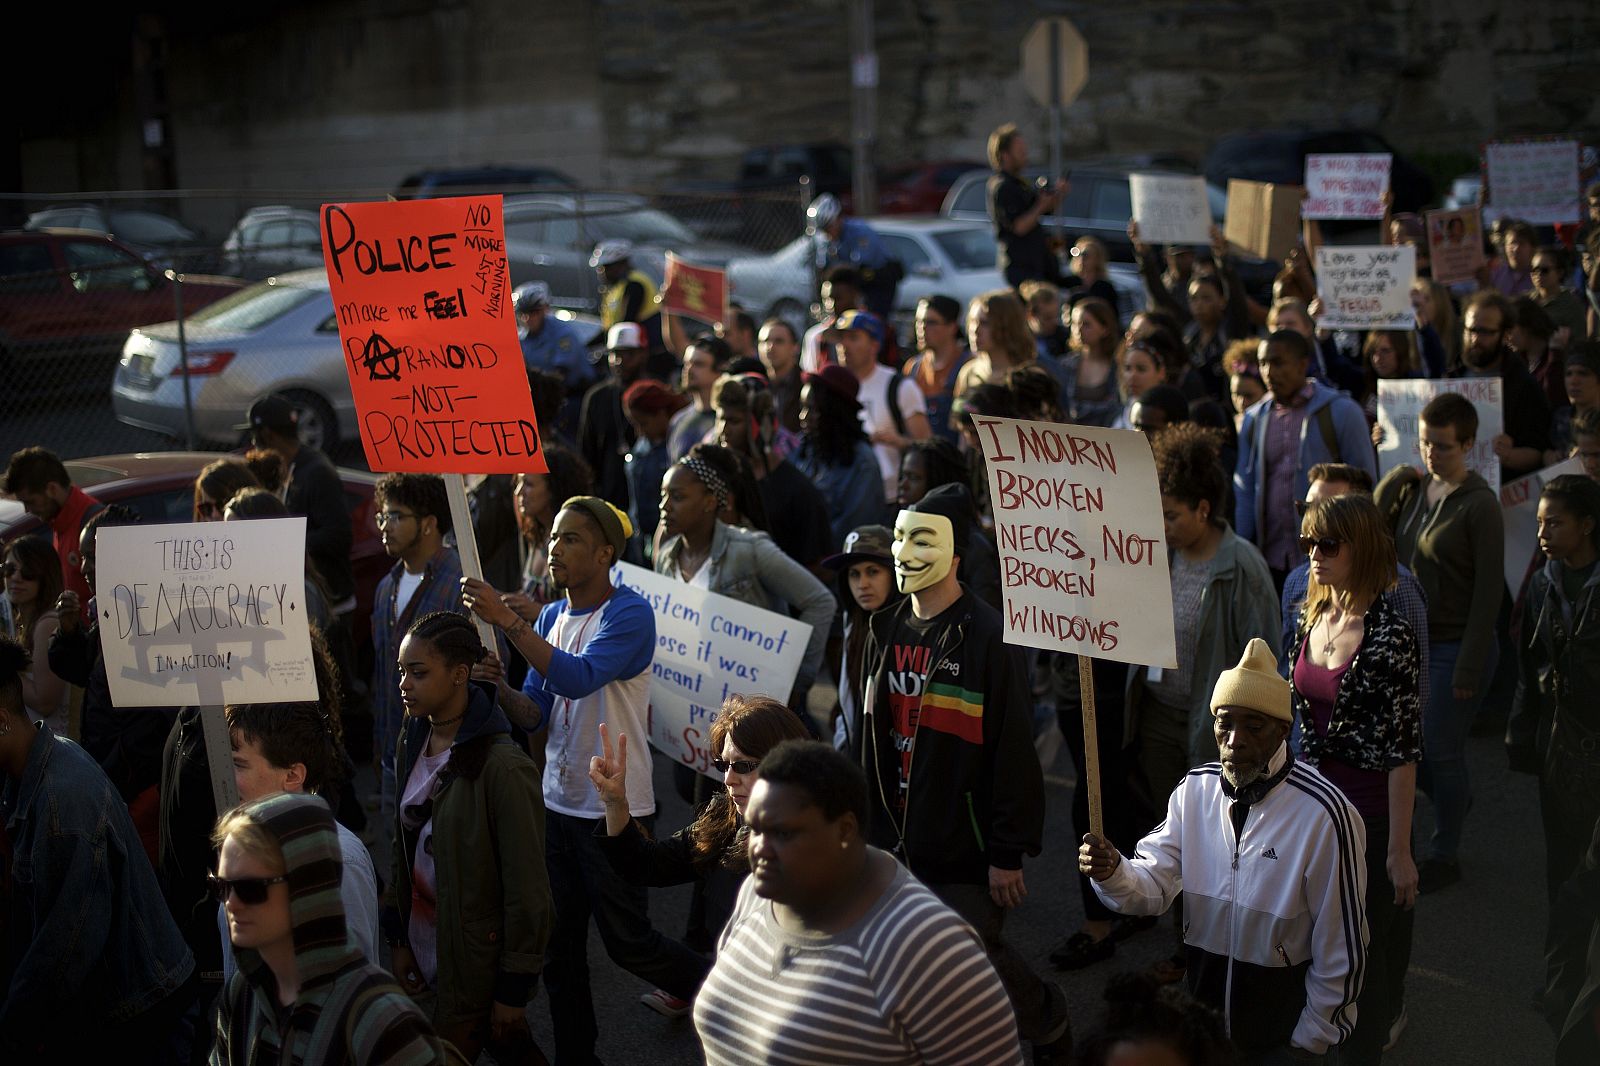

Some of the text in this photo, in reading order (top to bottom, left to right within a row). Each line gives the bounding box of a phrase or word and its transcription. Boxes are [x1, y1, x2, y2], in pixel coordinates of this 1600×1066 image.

[464, 203, 491, 227] NO
[325, 205, 457, 283] POLICE
[464, 235, 503, 253] MORE
[471, 254, 494, 294] LAST
[482, 257, 506, 319] WARNING
[346, 329, 498, 381] PARANOID
[365, 411, 538, 465] PROTECTED
[978, 420, 1118, 475] I MOURN
[996, 469, 1104, 513] BROKEN
[1102, 524, 1160, 566] NOT
[1003, 556, 1095, 598] BROKEN
[113, 582, 288, 640] DEMOCRACY
[710, 613, 789, 654] cannot
[1007, 598, 1120, 651] WINDOWS
[655, 635, 760, 682] ose it was
[690, 703, 718, 725] pro
